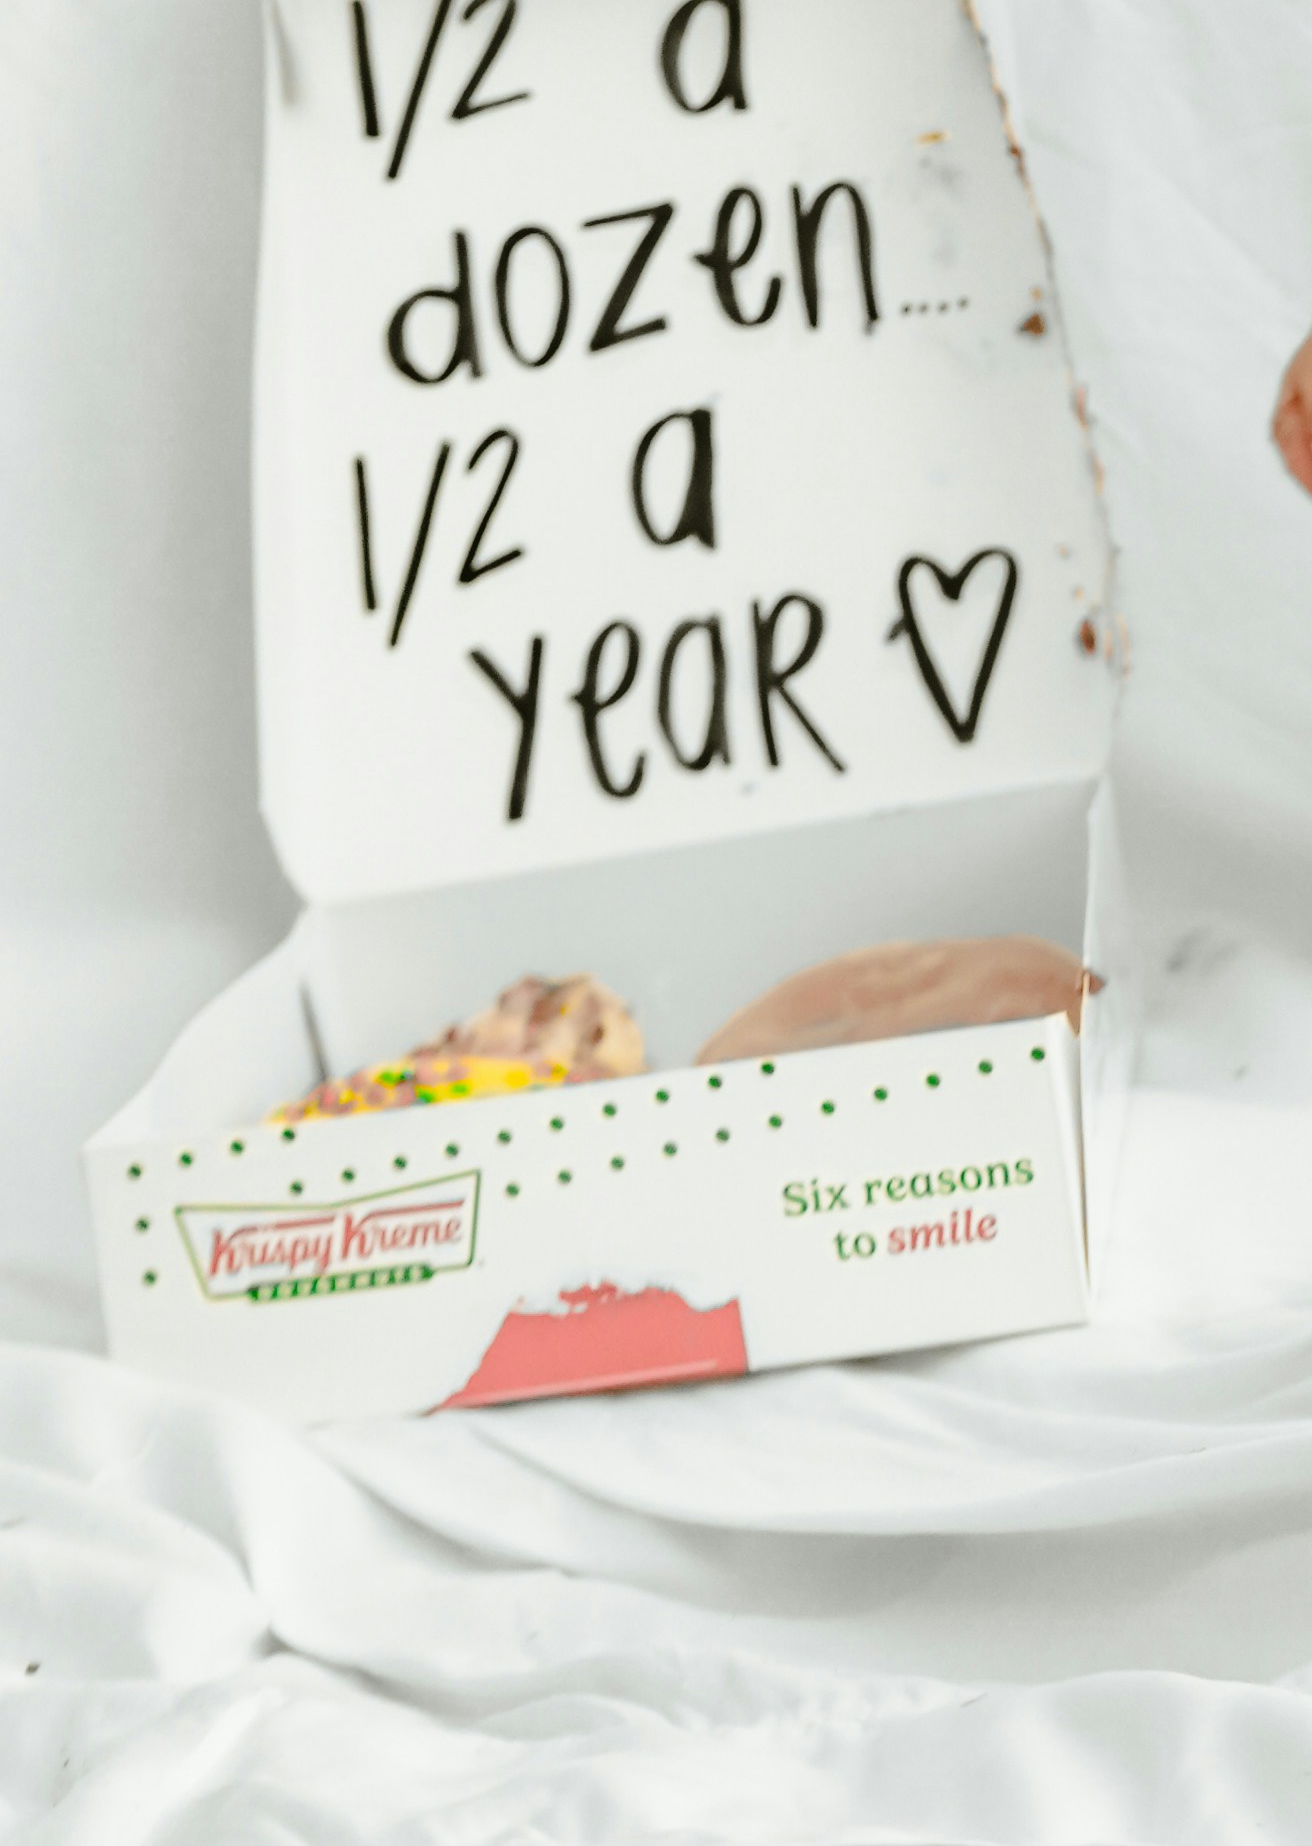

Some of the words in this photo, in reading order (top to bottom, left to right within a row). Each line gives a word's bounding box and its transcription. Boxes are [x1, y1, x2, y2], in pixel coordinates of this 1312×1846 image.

[353, 427, 526, 649] 1/2
[782, 1178, 850, 1218] Six
[863, 1157, 1035, 1205] reasons
[207, 1214, 337, 1278] Krispy
[339, 1199, 466, 1261] Kreme
[833, 1230, 877, 1261] to
[888, 1206, 998, 1255] smile
